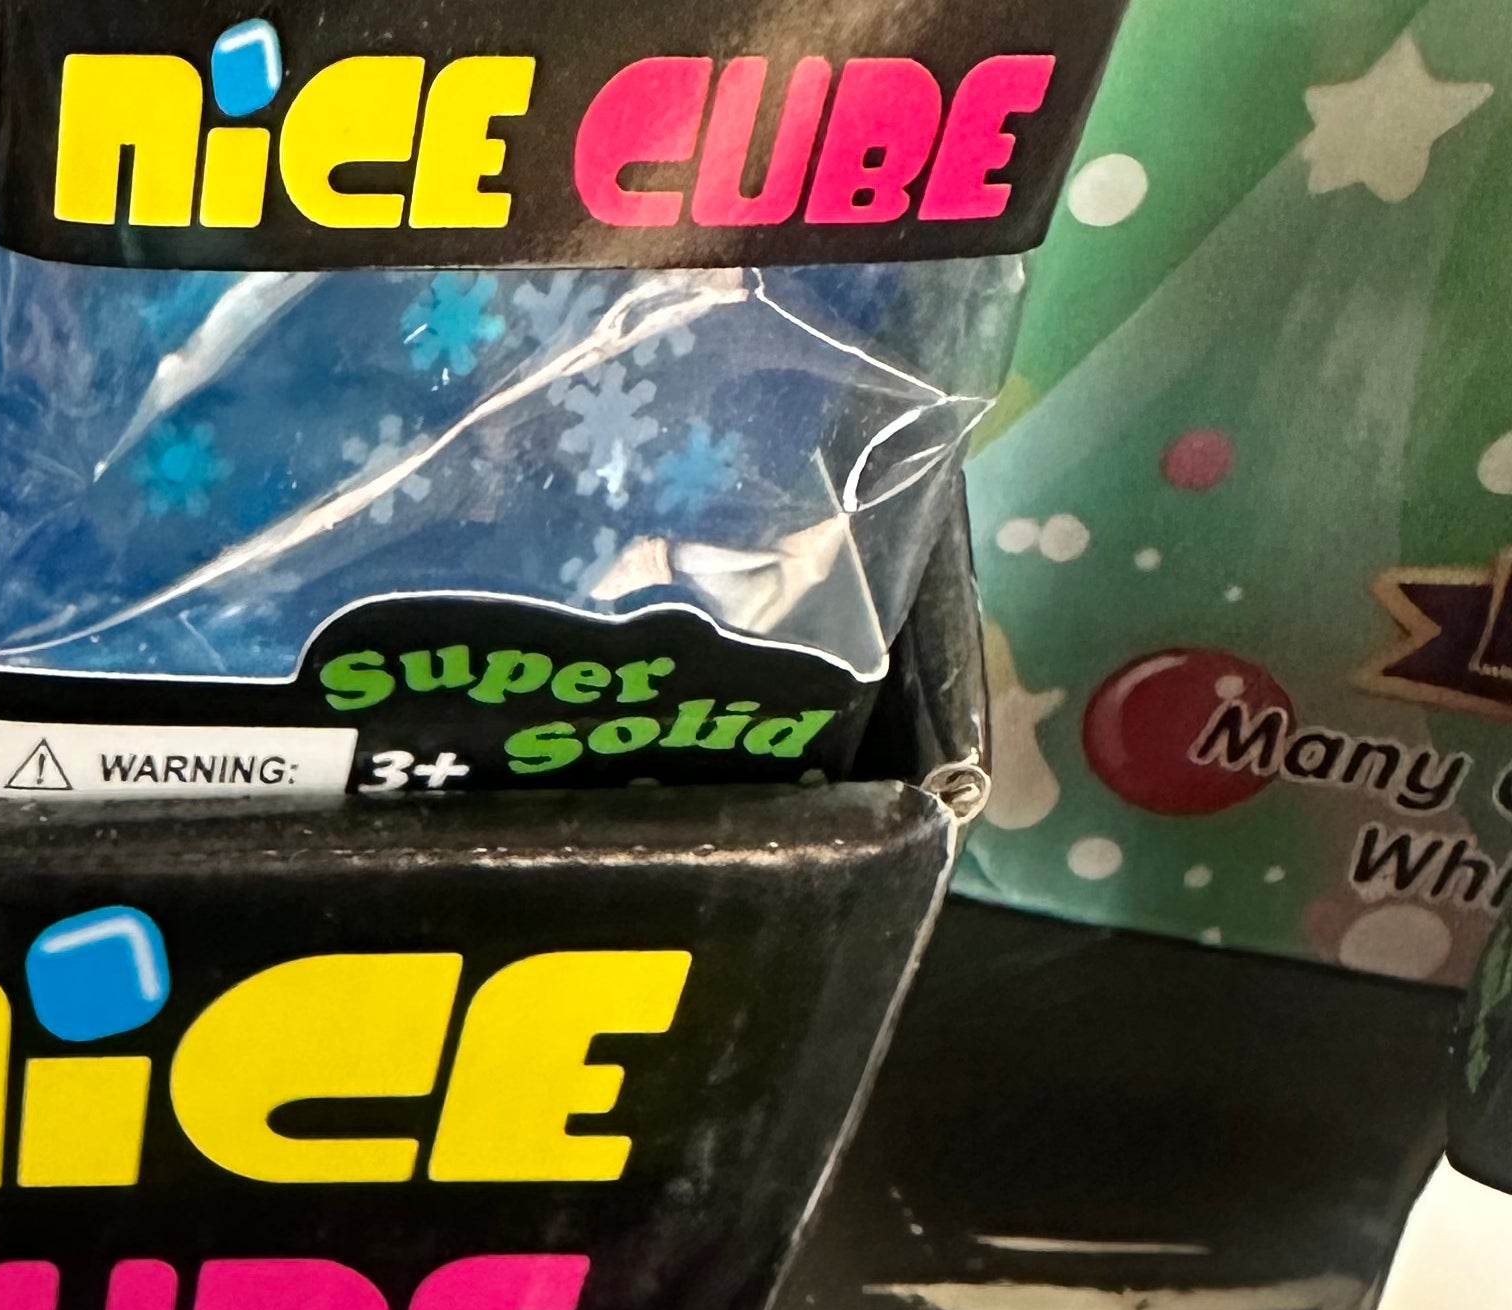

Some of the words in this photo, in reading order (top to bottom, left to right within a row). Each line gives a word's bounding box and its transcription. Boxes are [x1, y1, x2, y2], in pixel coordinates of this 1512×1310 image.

[572, 54, 1056, 228] CUBE
[320, 645, 678, 710] Super
[100, 753, 299, 785] WARNING:
[359, 750, 471, 793] 3+
[504, 699, 836, 775] Solid
[1193, 700, 1472, 813] Many
